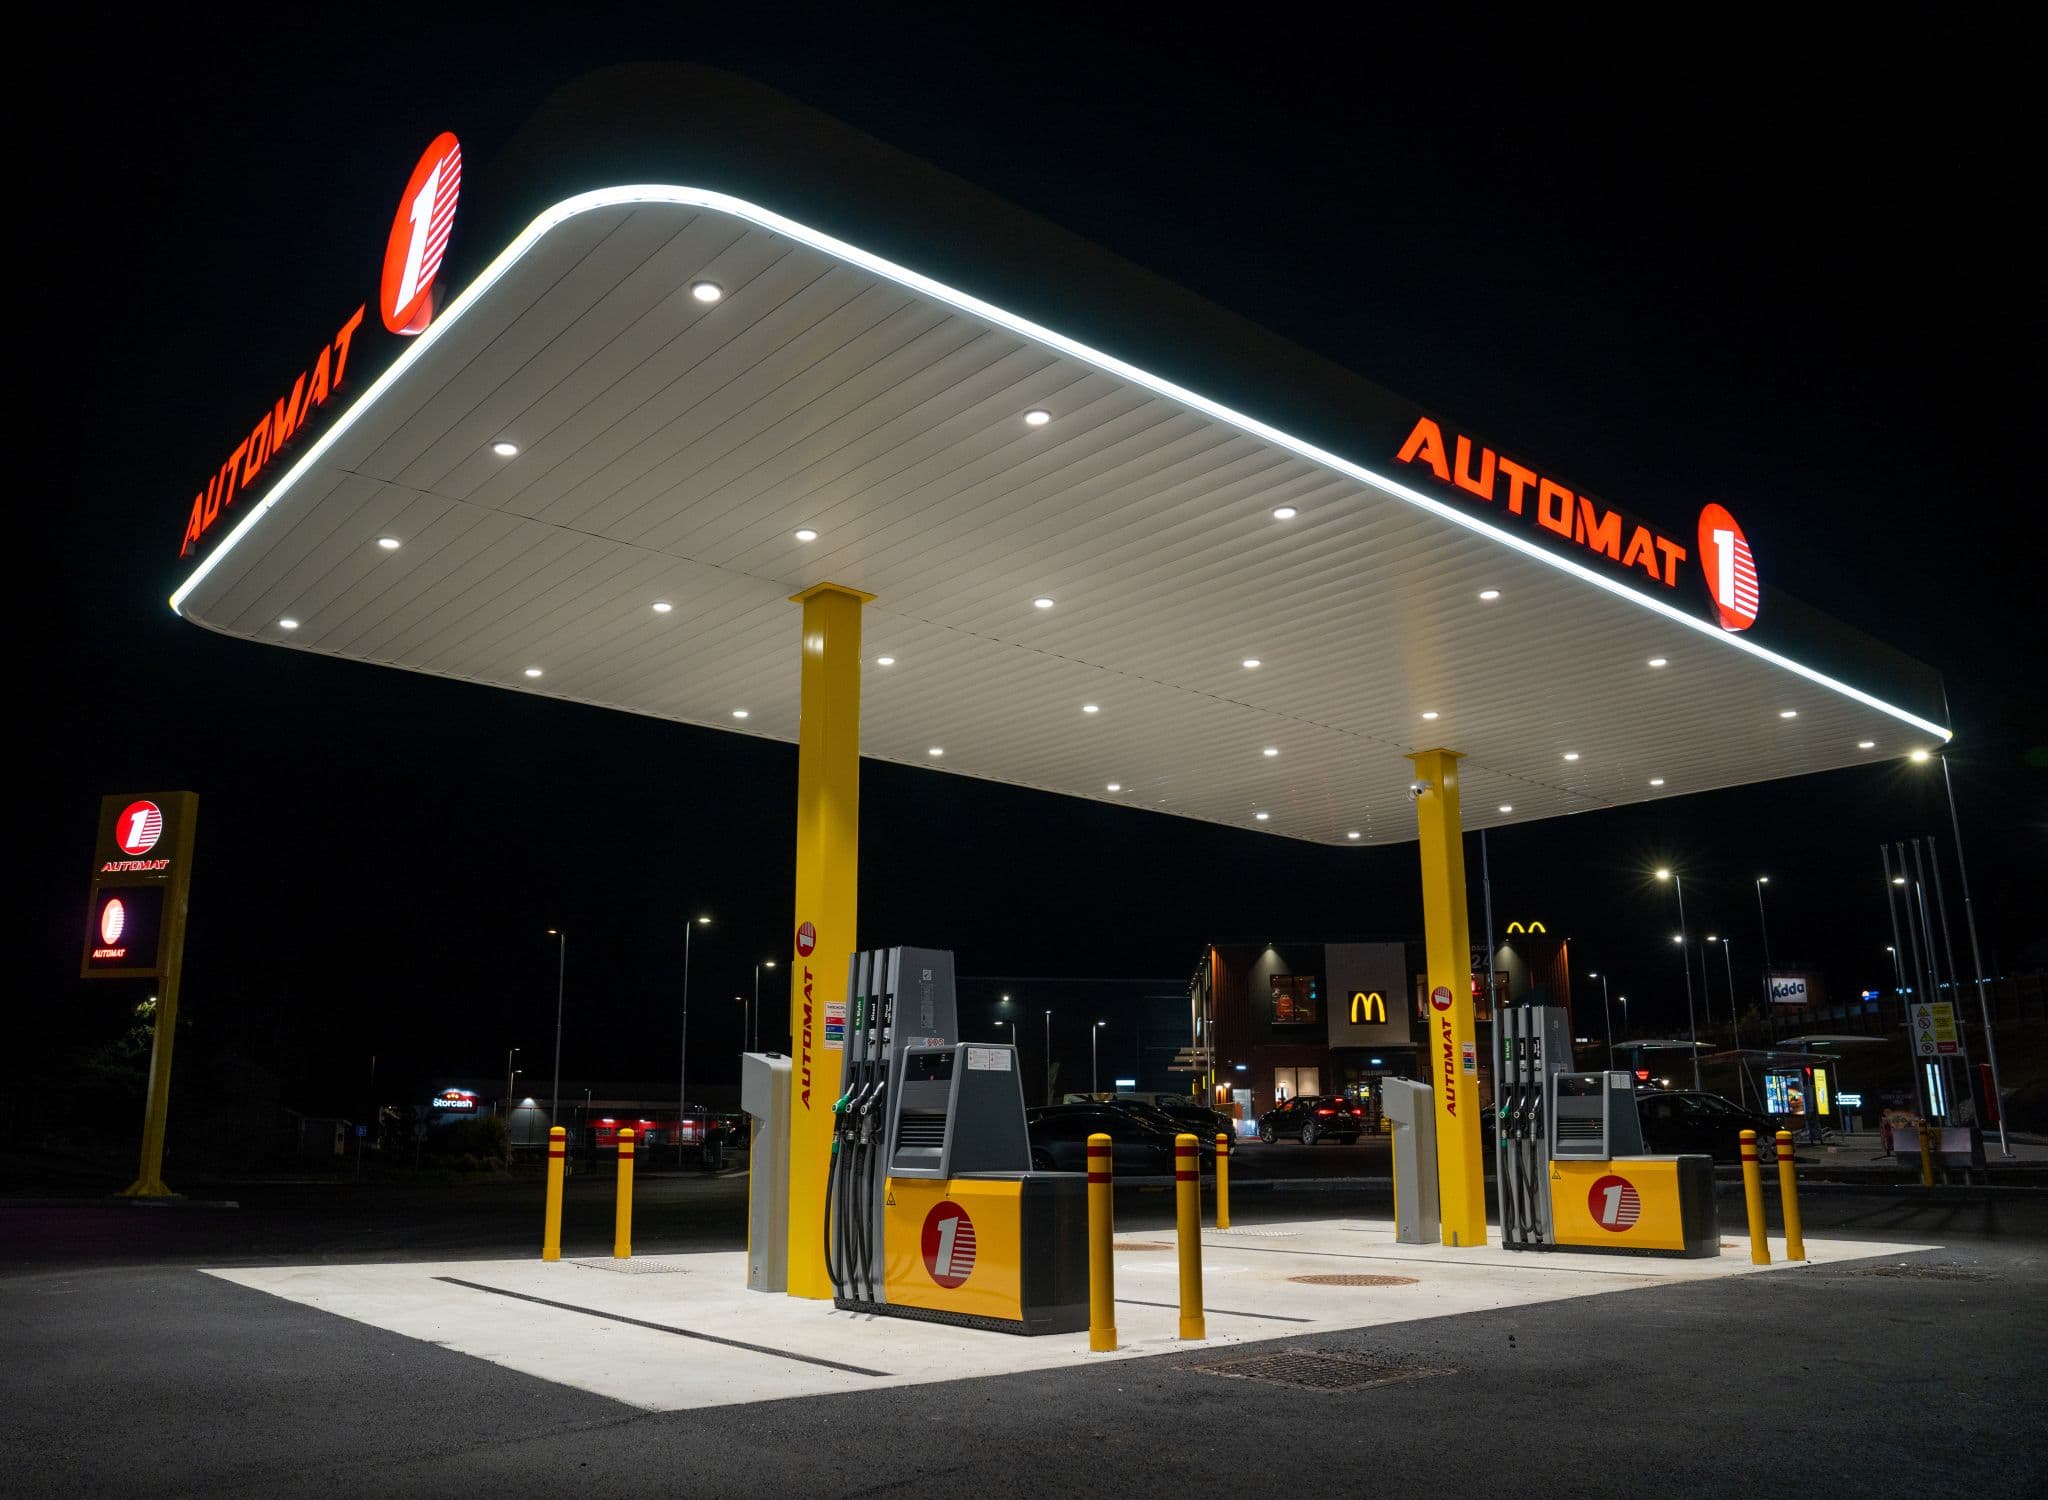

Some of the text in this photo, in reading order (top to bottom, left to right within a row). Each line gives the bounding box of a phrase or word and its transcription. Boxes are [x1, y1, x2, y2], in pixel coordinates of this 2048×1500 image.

[179, 157, 442, 558] AUTOMAT 1
[1396, 416, 1735, 610] AUTOMAT 1
[125, 808, 150, 848] 1
[101, 859, 170, 872] AUTOMAT
[92, 949, 126, 958] AUTOMAT
[801, 965, 814, 1111] AUTOMAT
[1442, 1016, 1456, 1118] AUTOMAT
[433, 1098, 472, 1108] Storcash
